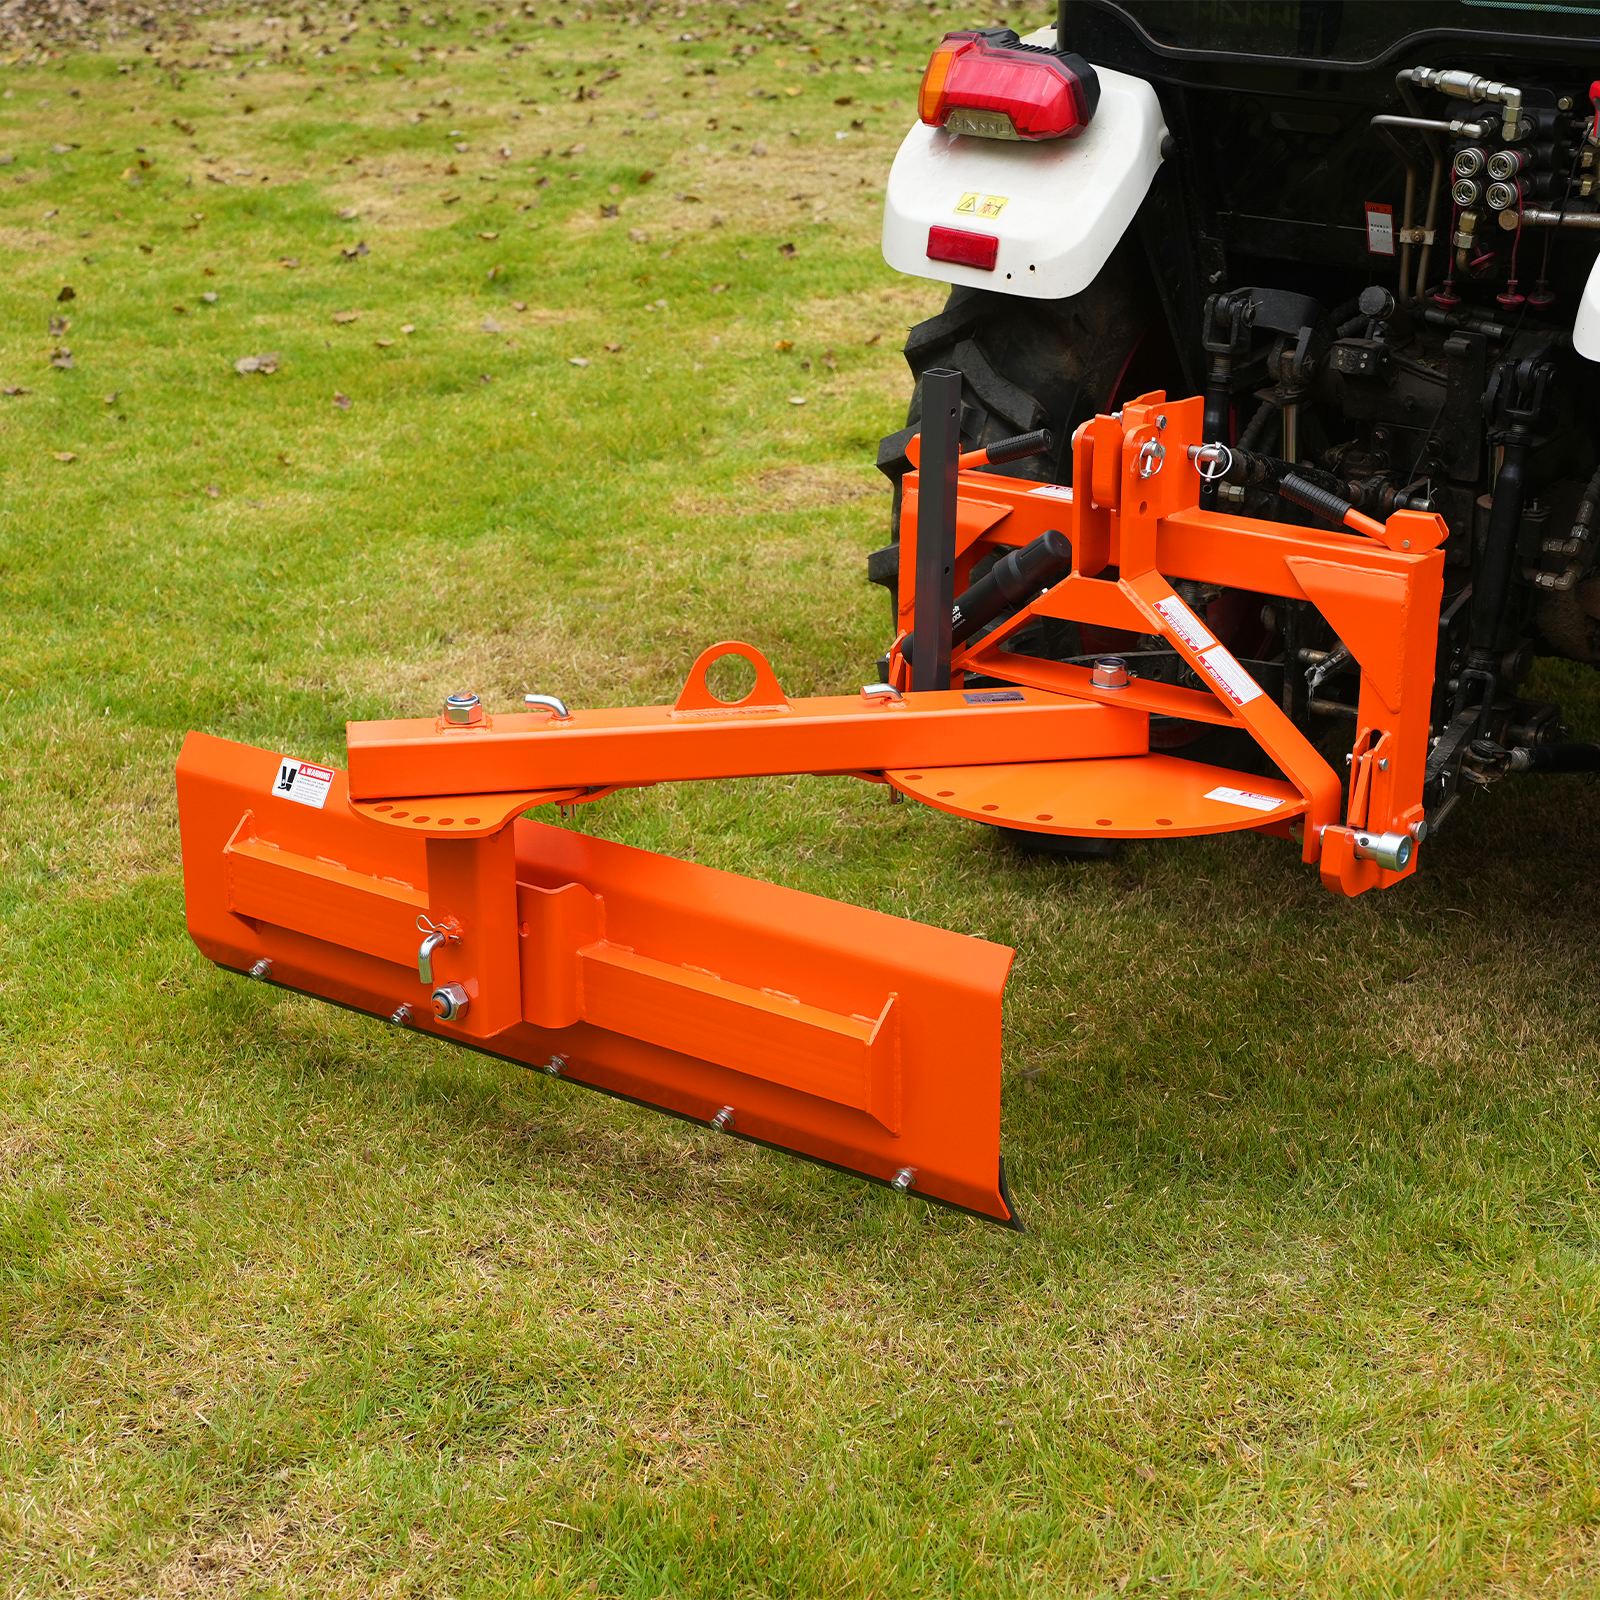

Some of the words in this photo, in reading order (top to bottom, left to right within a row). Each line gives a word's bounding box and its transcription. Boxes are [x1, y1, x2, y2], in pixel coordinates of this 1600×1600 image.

[1164, 614, 1188, 640] DANGER
[1208, 667, 1231, 692] CAUTION
[306, 767, 331, 781] WARNING
